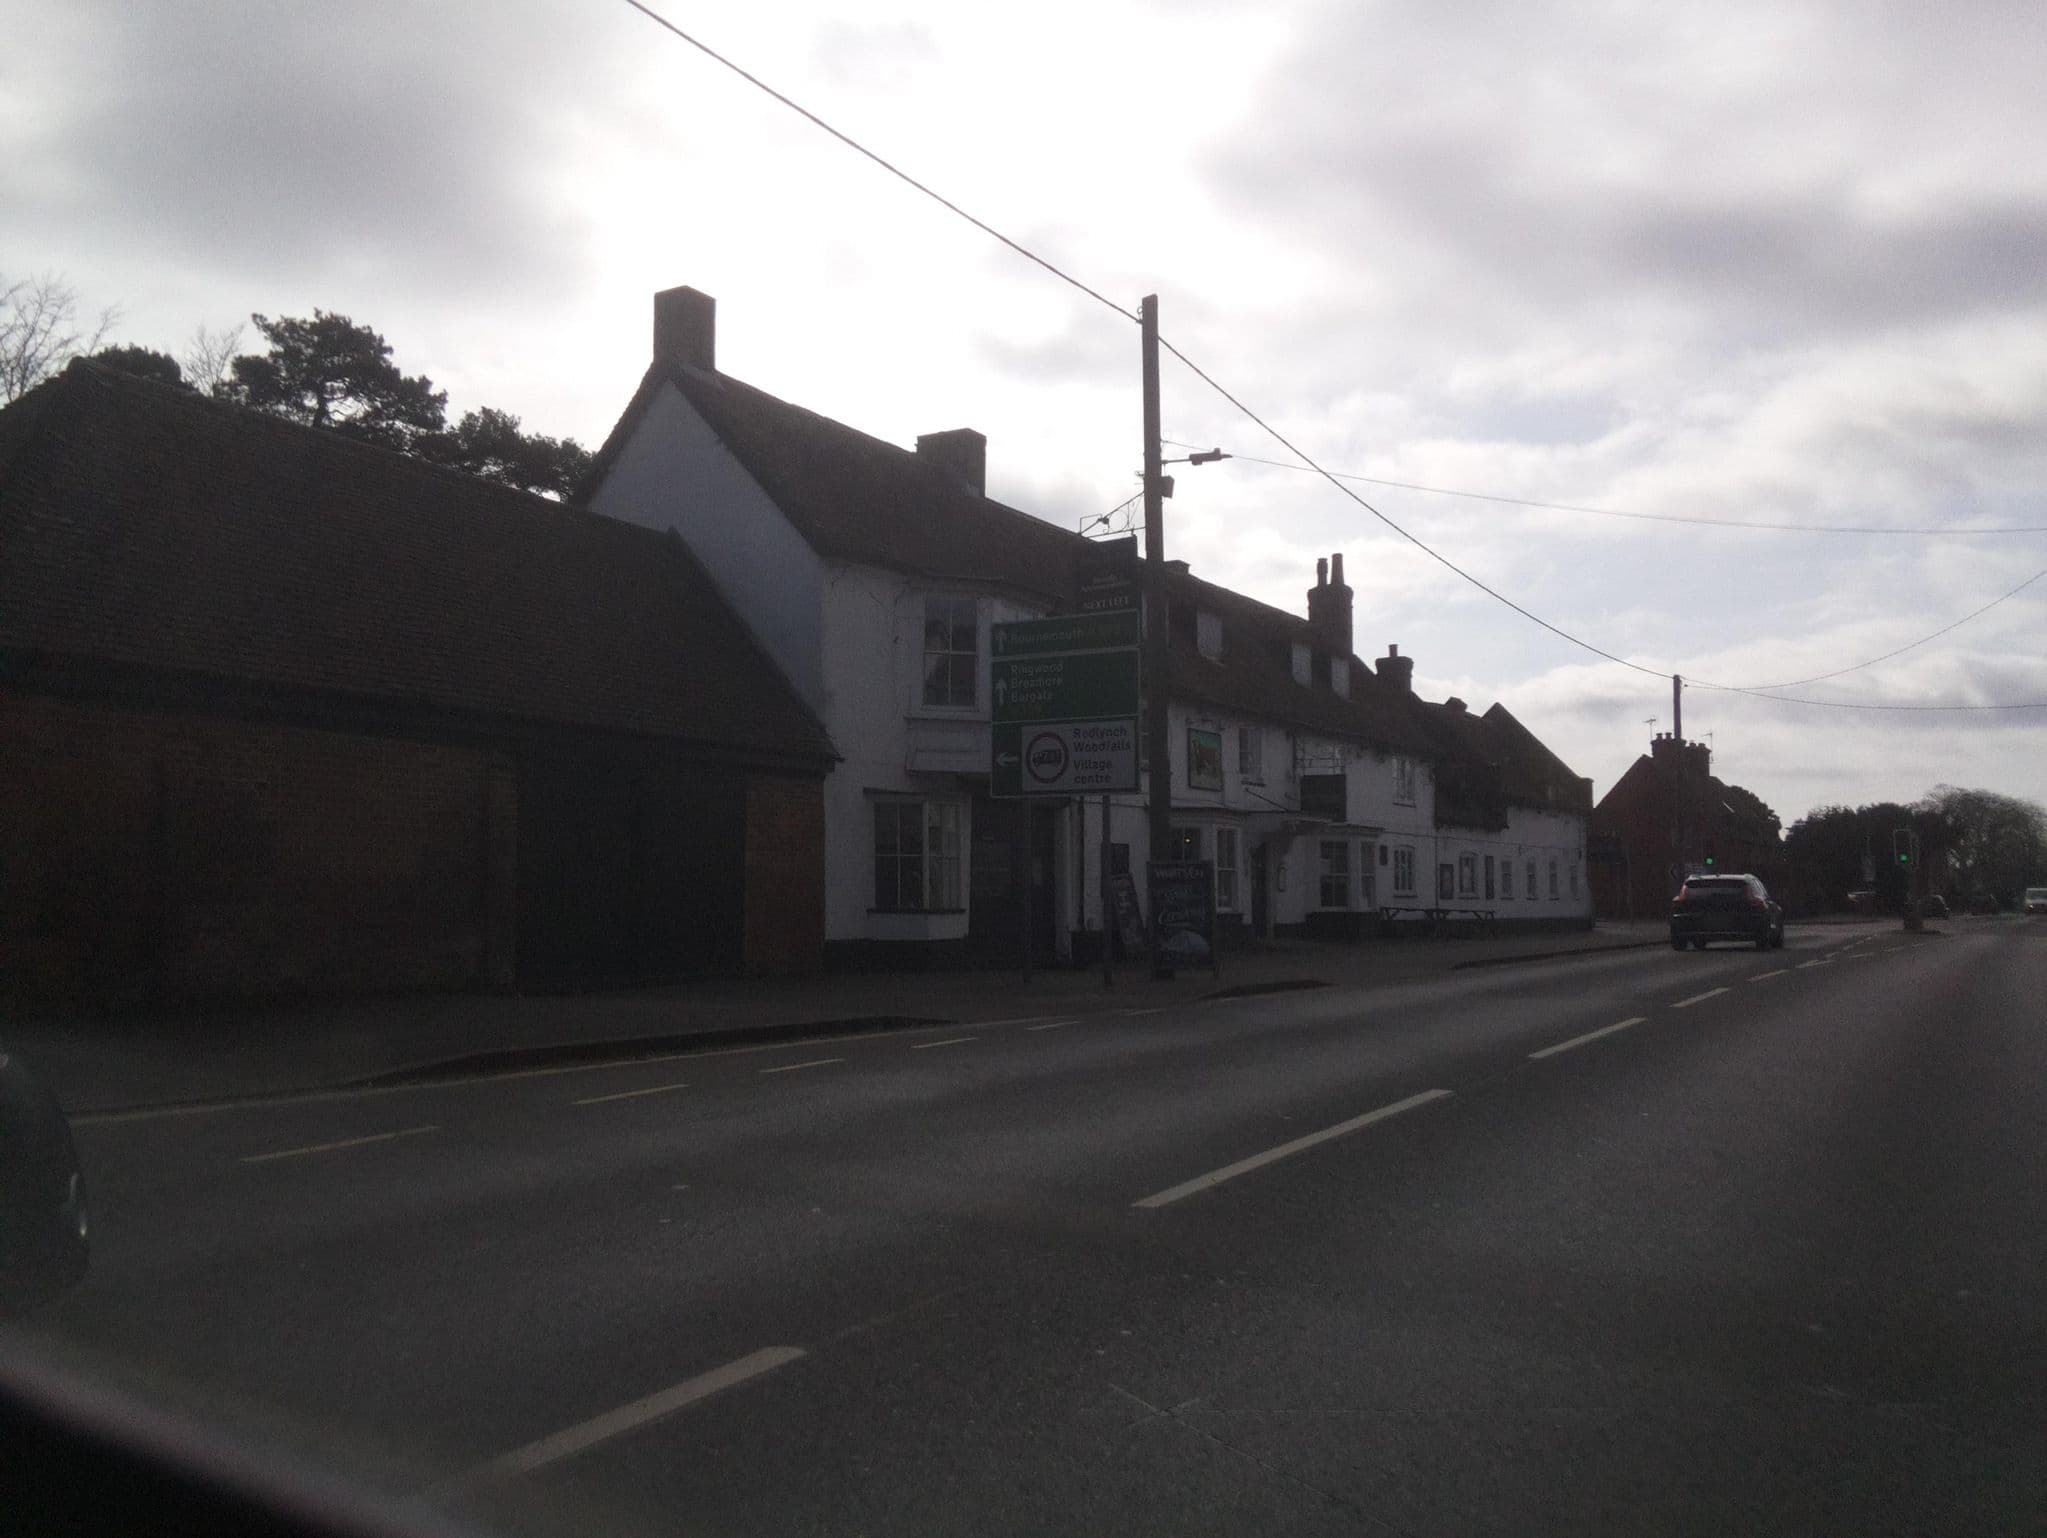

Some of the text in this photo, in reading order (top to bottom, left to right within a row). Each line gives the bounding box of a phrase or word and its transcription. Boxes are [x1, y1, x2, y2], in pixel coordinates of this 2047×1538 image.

[1011, 628, 1085, 643] Bournemouth
[1011, 661, 1064, 676] Ringwood
[1073, 727, 1129, 741] Redlynch
[1073, 740, 1132, 753] Woodfalls
[1073, 759, 1114, 771] Village
[1074, 773, 1112, 784] centre
